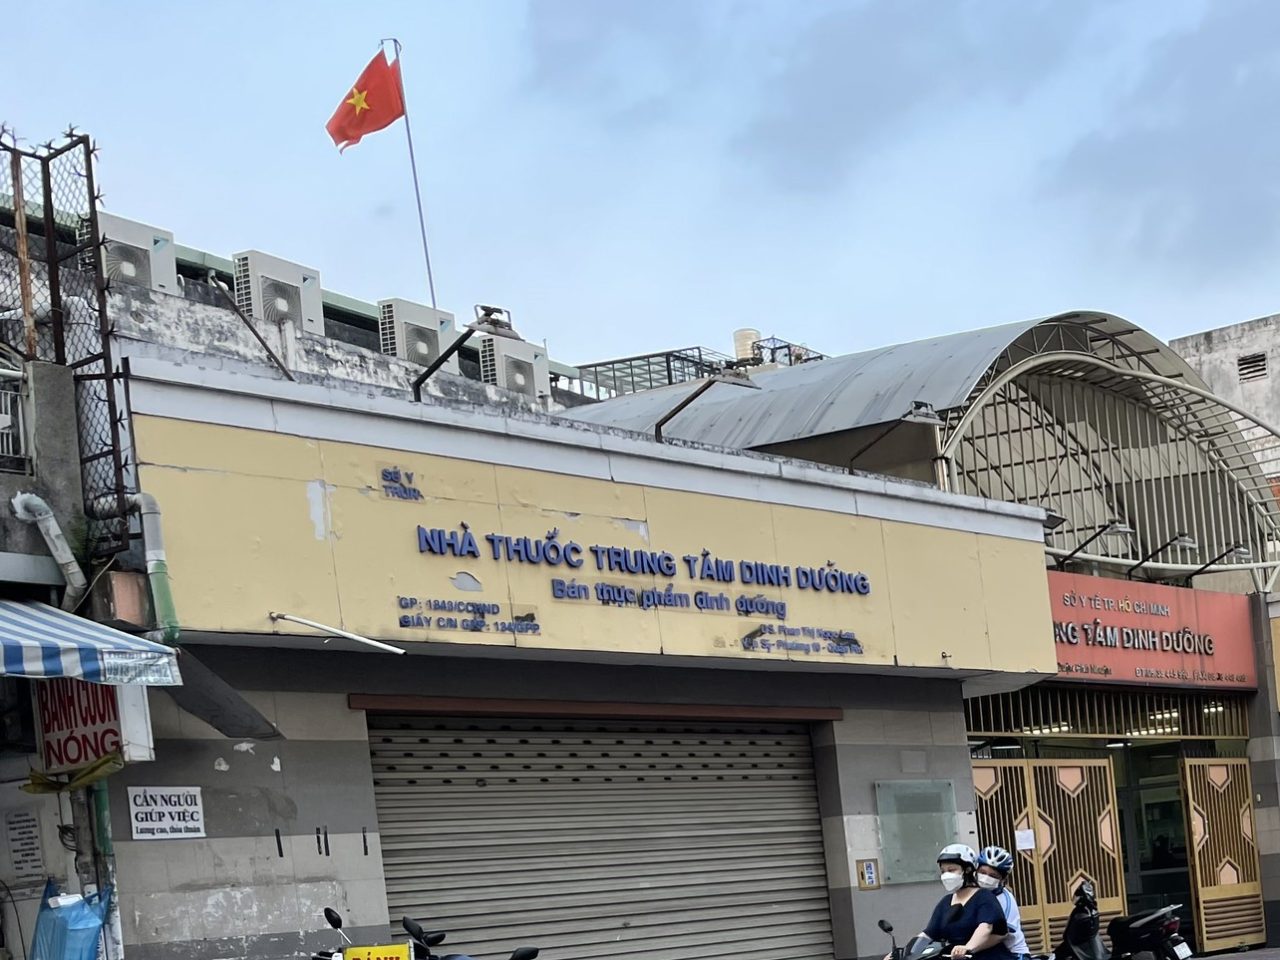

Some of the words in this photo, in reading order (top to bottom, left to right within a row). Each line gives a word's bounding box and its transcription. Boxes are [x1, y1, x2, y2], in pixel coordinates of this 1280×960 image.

[417, 521, 480, 557] NHÀ
[486, 527, 584, 568] THUỐC
[590, 544, 677, 577] TRUNG
[683, 548, 735, 582] TÂM
[741, 560, 791, 587] DINH
[552, 577, 590, 600] Bán
[694, 591, 730, 611] dinh
[1080, 595, 1087, 607] Y
[1149, 603, 1170, 617] MINH
[1082, 618, 1120, 648] TÂM
[1121, 627, 1159, 651] DINH
[45, 729, 121, 766] NÓNG
[133, 789, 157, 807] CẦN
[160, 791, 198, 807] NGƯỜI
[135, 808, 165, 822] GIÚP
[168, 808, 200, 823] VIỆC
